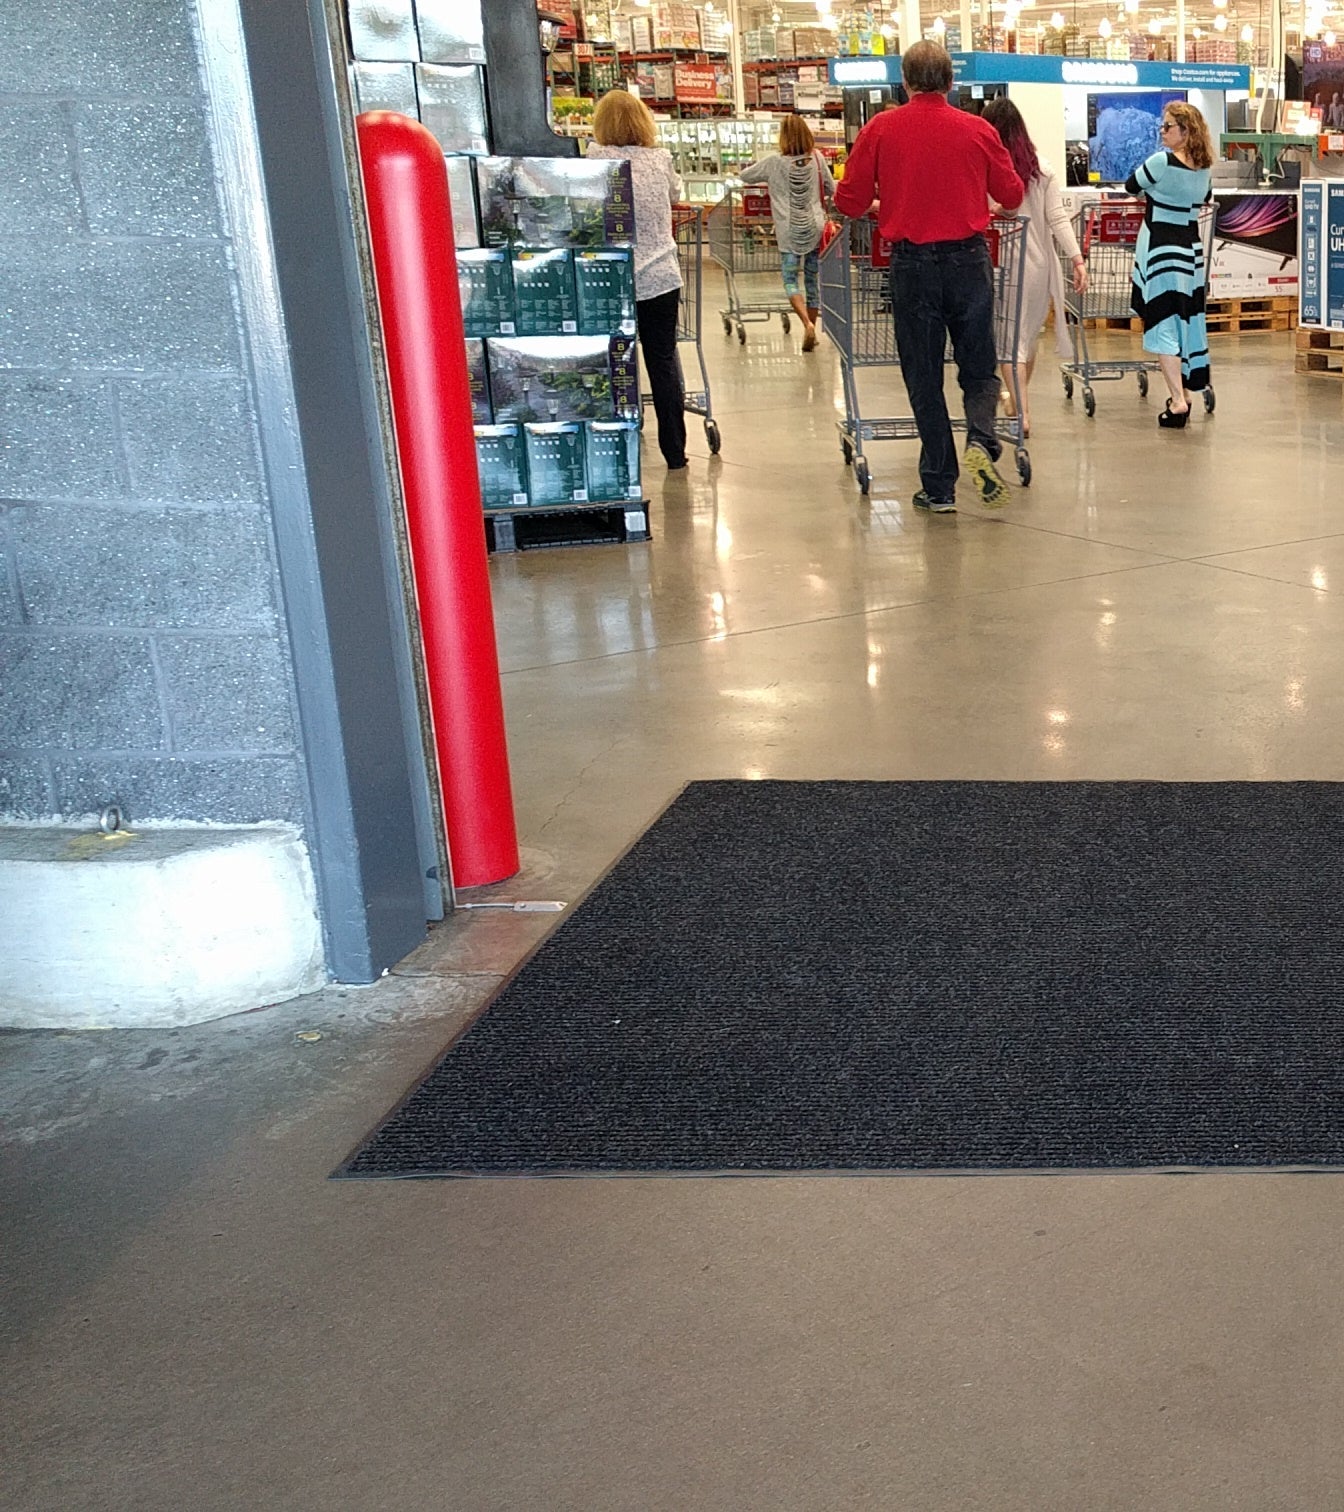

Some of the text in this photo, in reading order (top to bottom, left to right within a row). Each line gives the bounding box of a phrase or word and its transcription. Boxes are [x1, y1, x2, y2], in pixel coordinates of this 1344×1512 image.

[675, 69, 715, 80] Business
[675, 79, 712, 90] Delivery
[1062, 198, 1072, 208] LG
